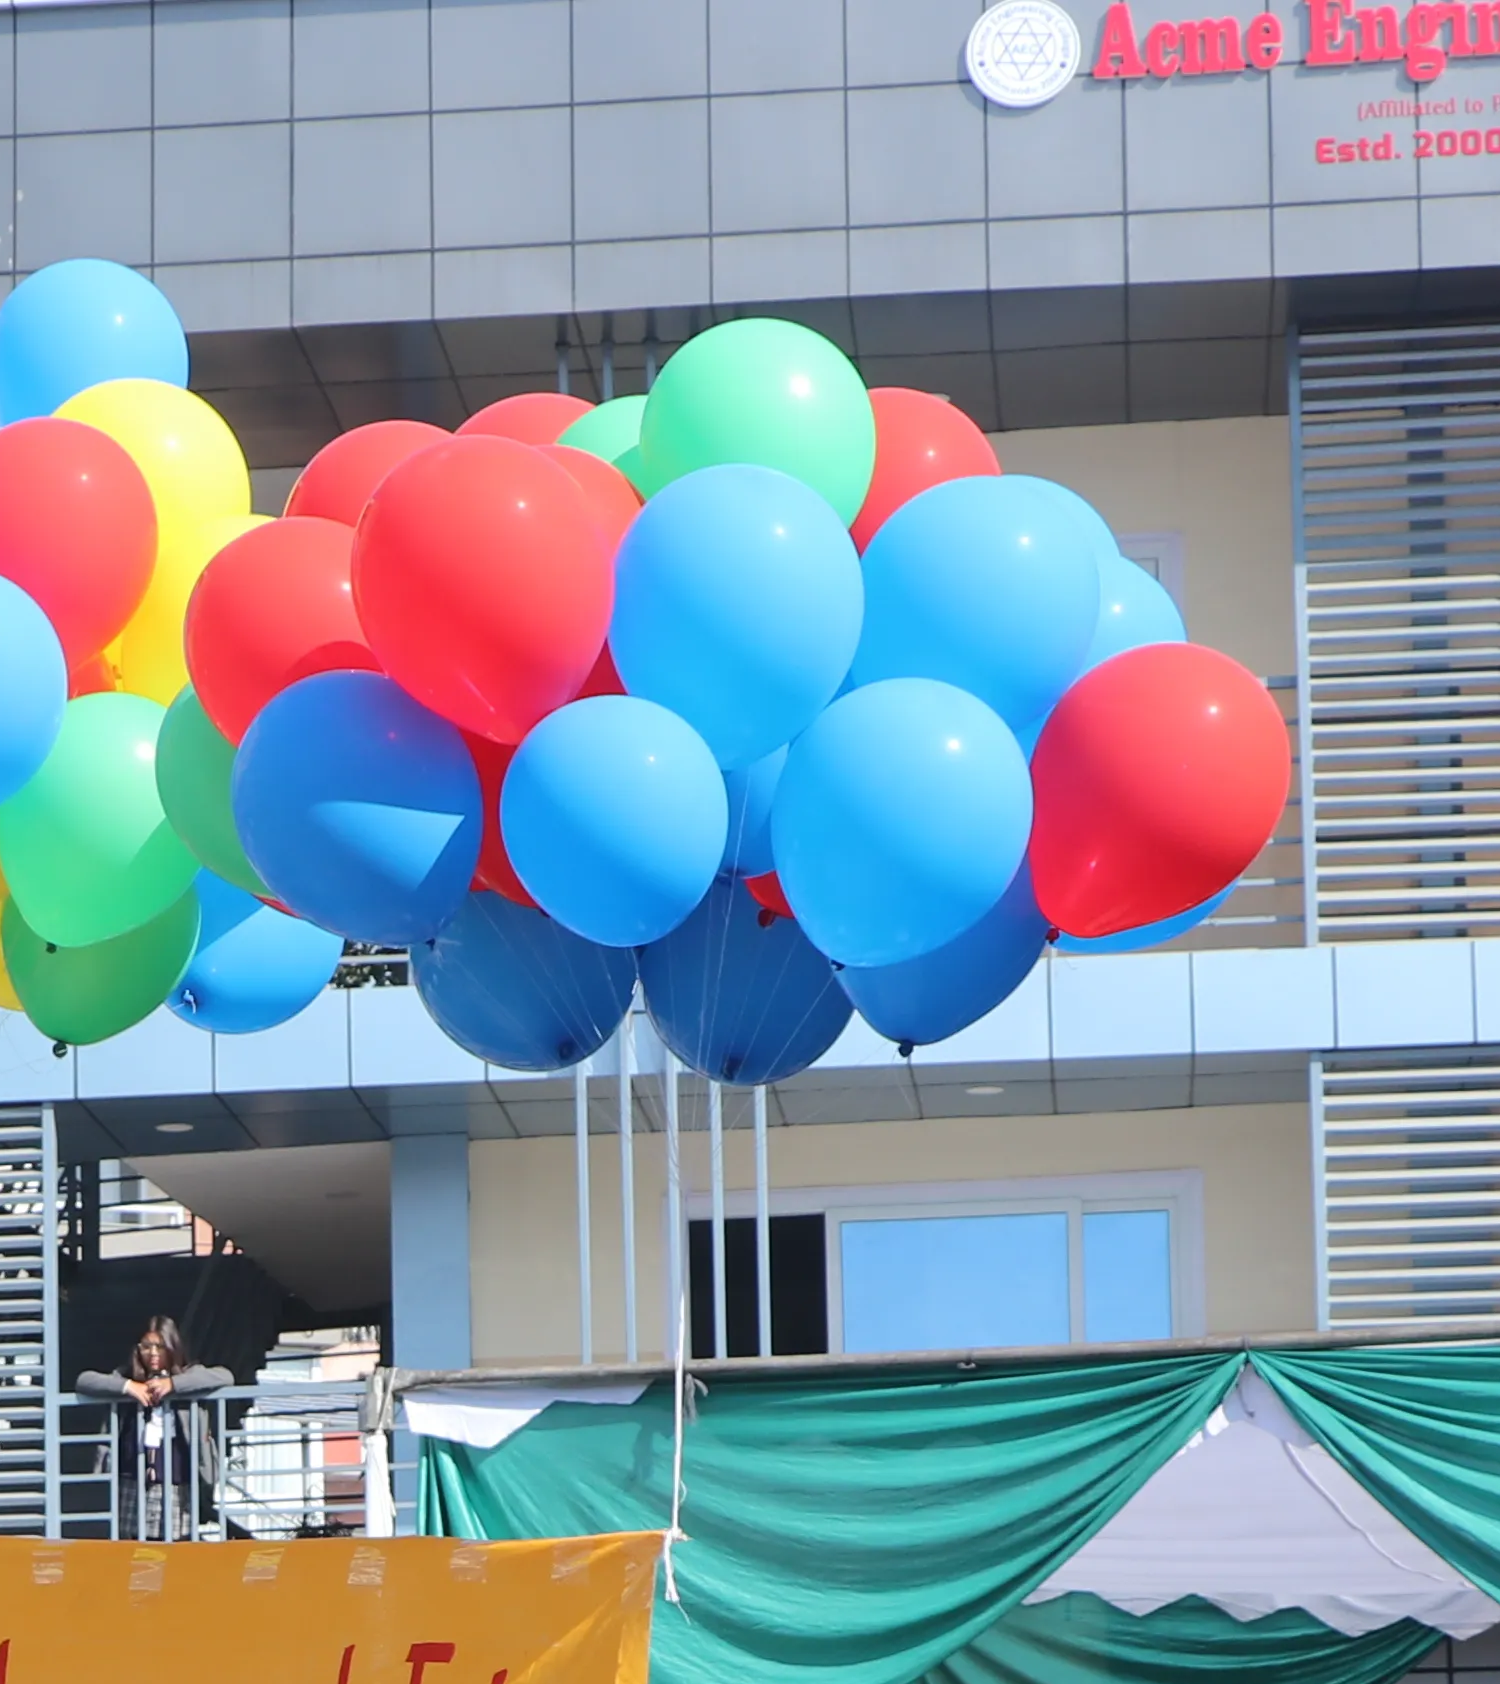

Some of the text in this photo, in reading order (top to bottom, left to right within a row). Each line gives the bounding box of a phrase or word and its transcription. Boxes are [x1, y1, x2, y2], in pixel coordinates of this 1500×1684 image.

[1092, 1, 1284, 79] Acme
[1357, 97, 1456, 121] (Affiliated
[1465, 97, 1484, 114] to
[1315, 132, 1403, 164] Estd.
